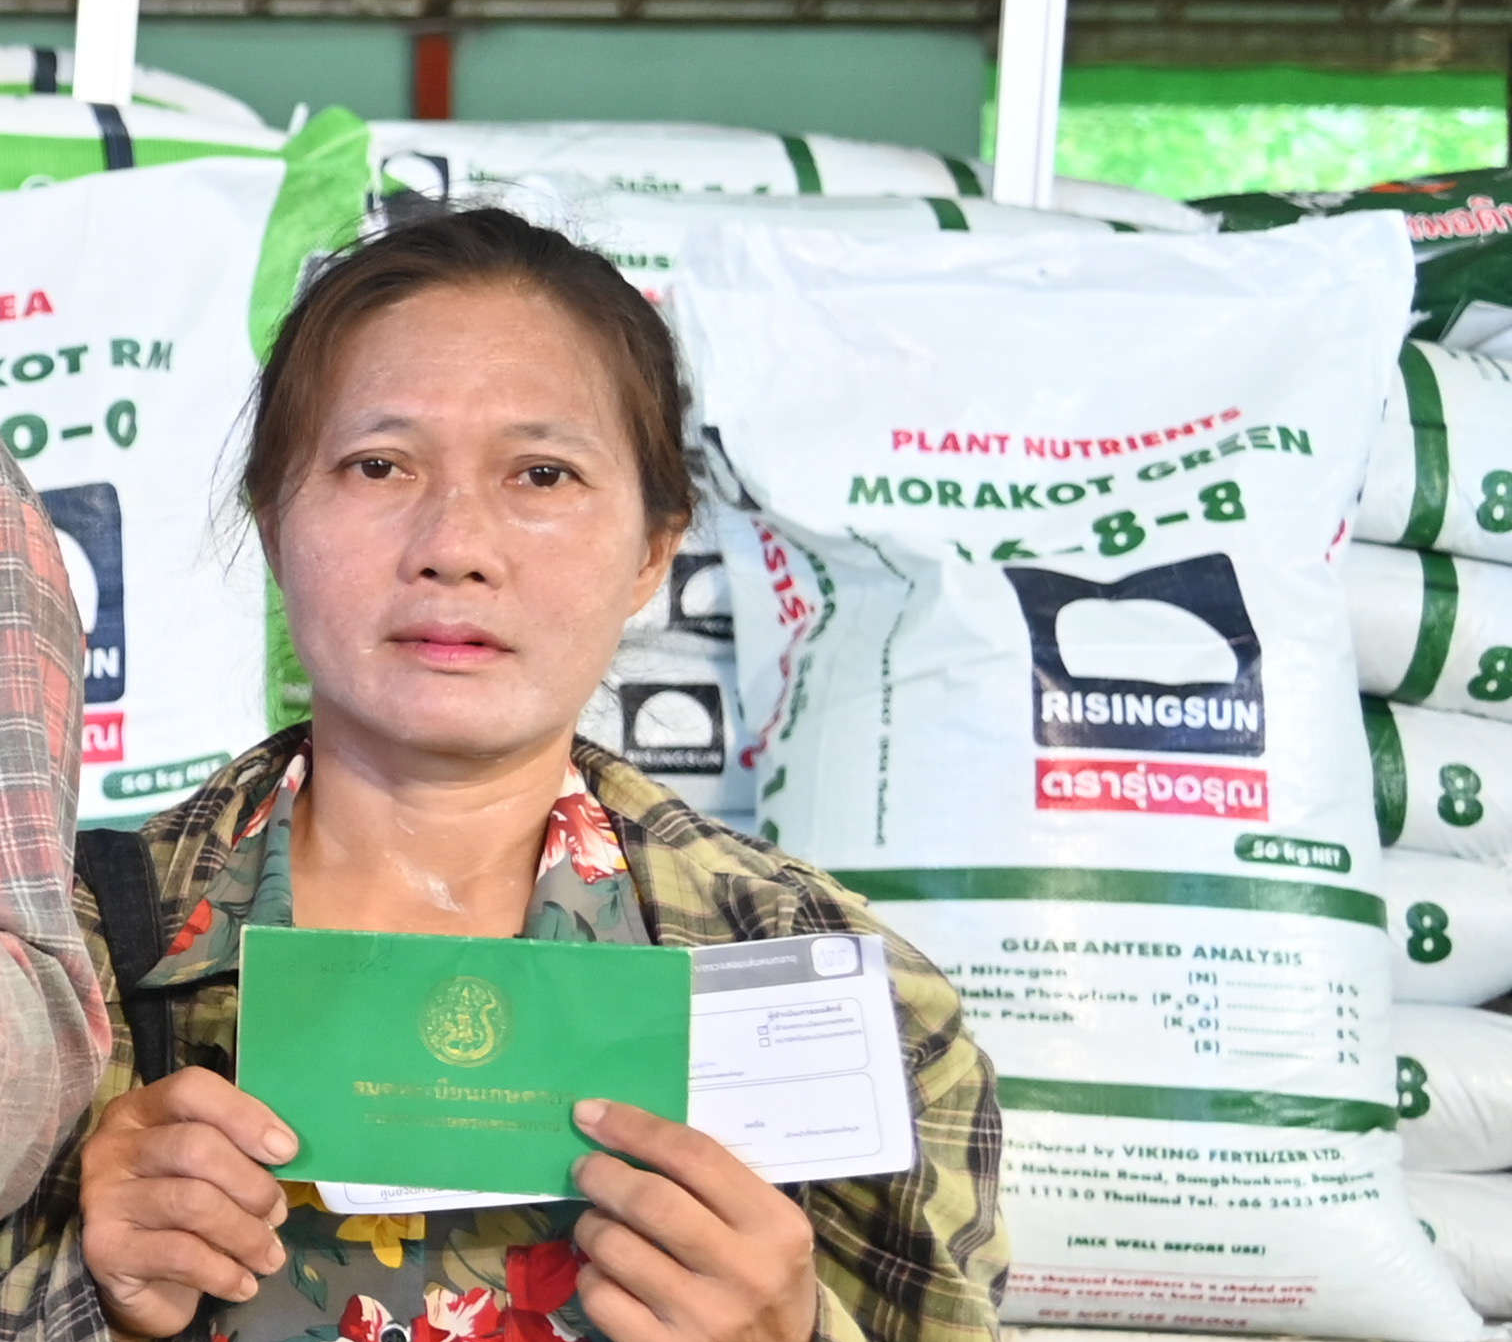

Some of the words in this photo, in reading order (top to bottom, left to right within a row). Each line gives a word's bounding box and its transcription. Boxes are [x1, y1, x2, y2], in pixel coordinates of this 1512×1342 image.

[891, 428, 1011, 456] PLANT
[1023, 405, 1243, 461] NUTRIENTS
[847, 474, 1116, 512] MORAKOT
[1136, 424, 1314, 485] GREEN
[1040, 689, 1259, 733] RISINGSUN
[1040, 762, 1263, 815] ตรารุ่งอรุณ
[1000, 937, 1183, 959] GUARANTEED
[1192, 944, 1303, 968] ANALYSIS
[1122, 1144, 1200, 1162] VIKING
